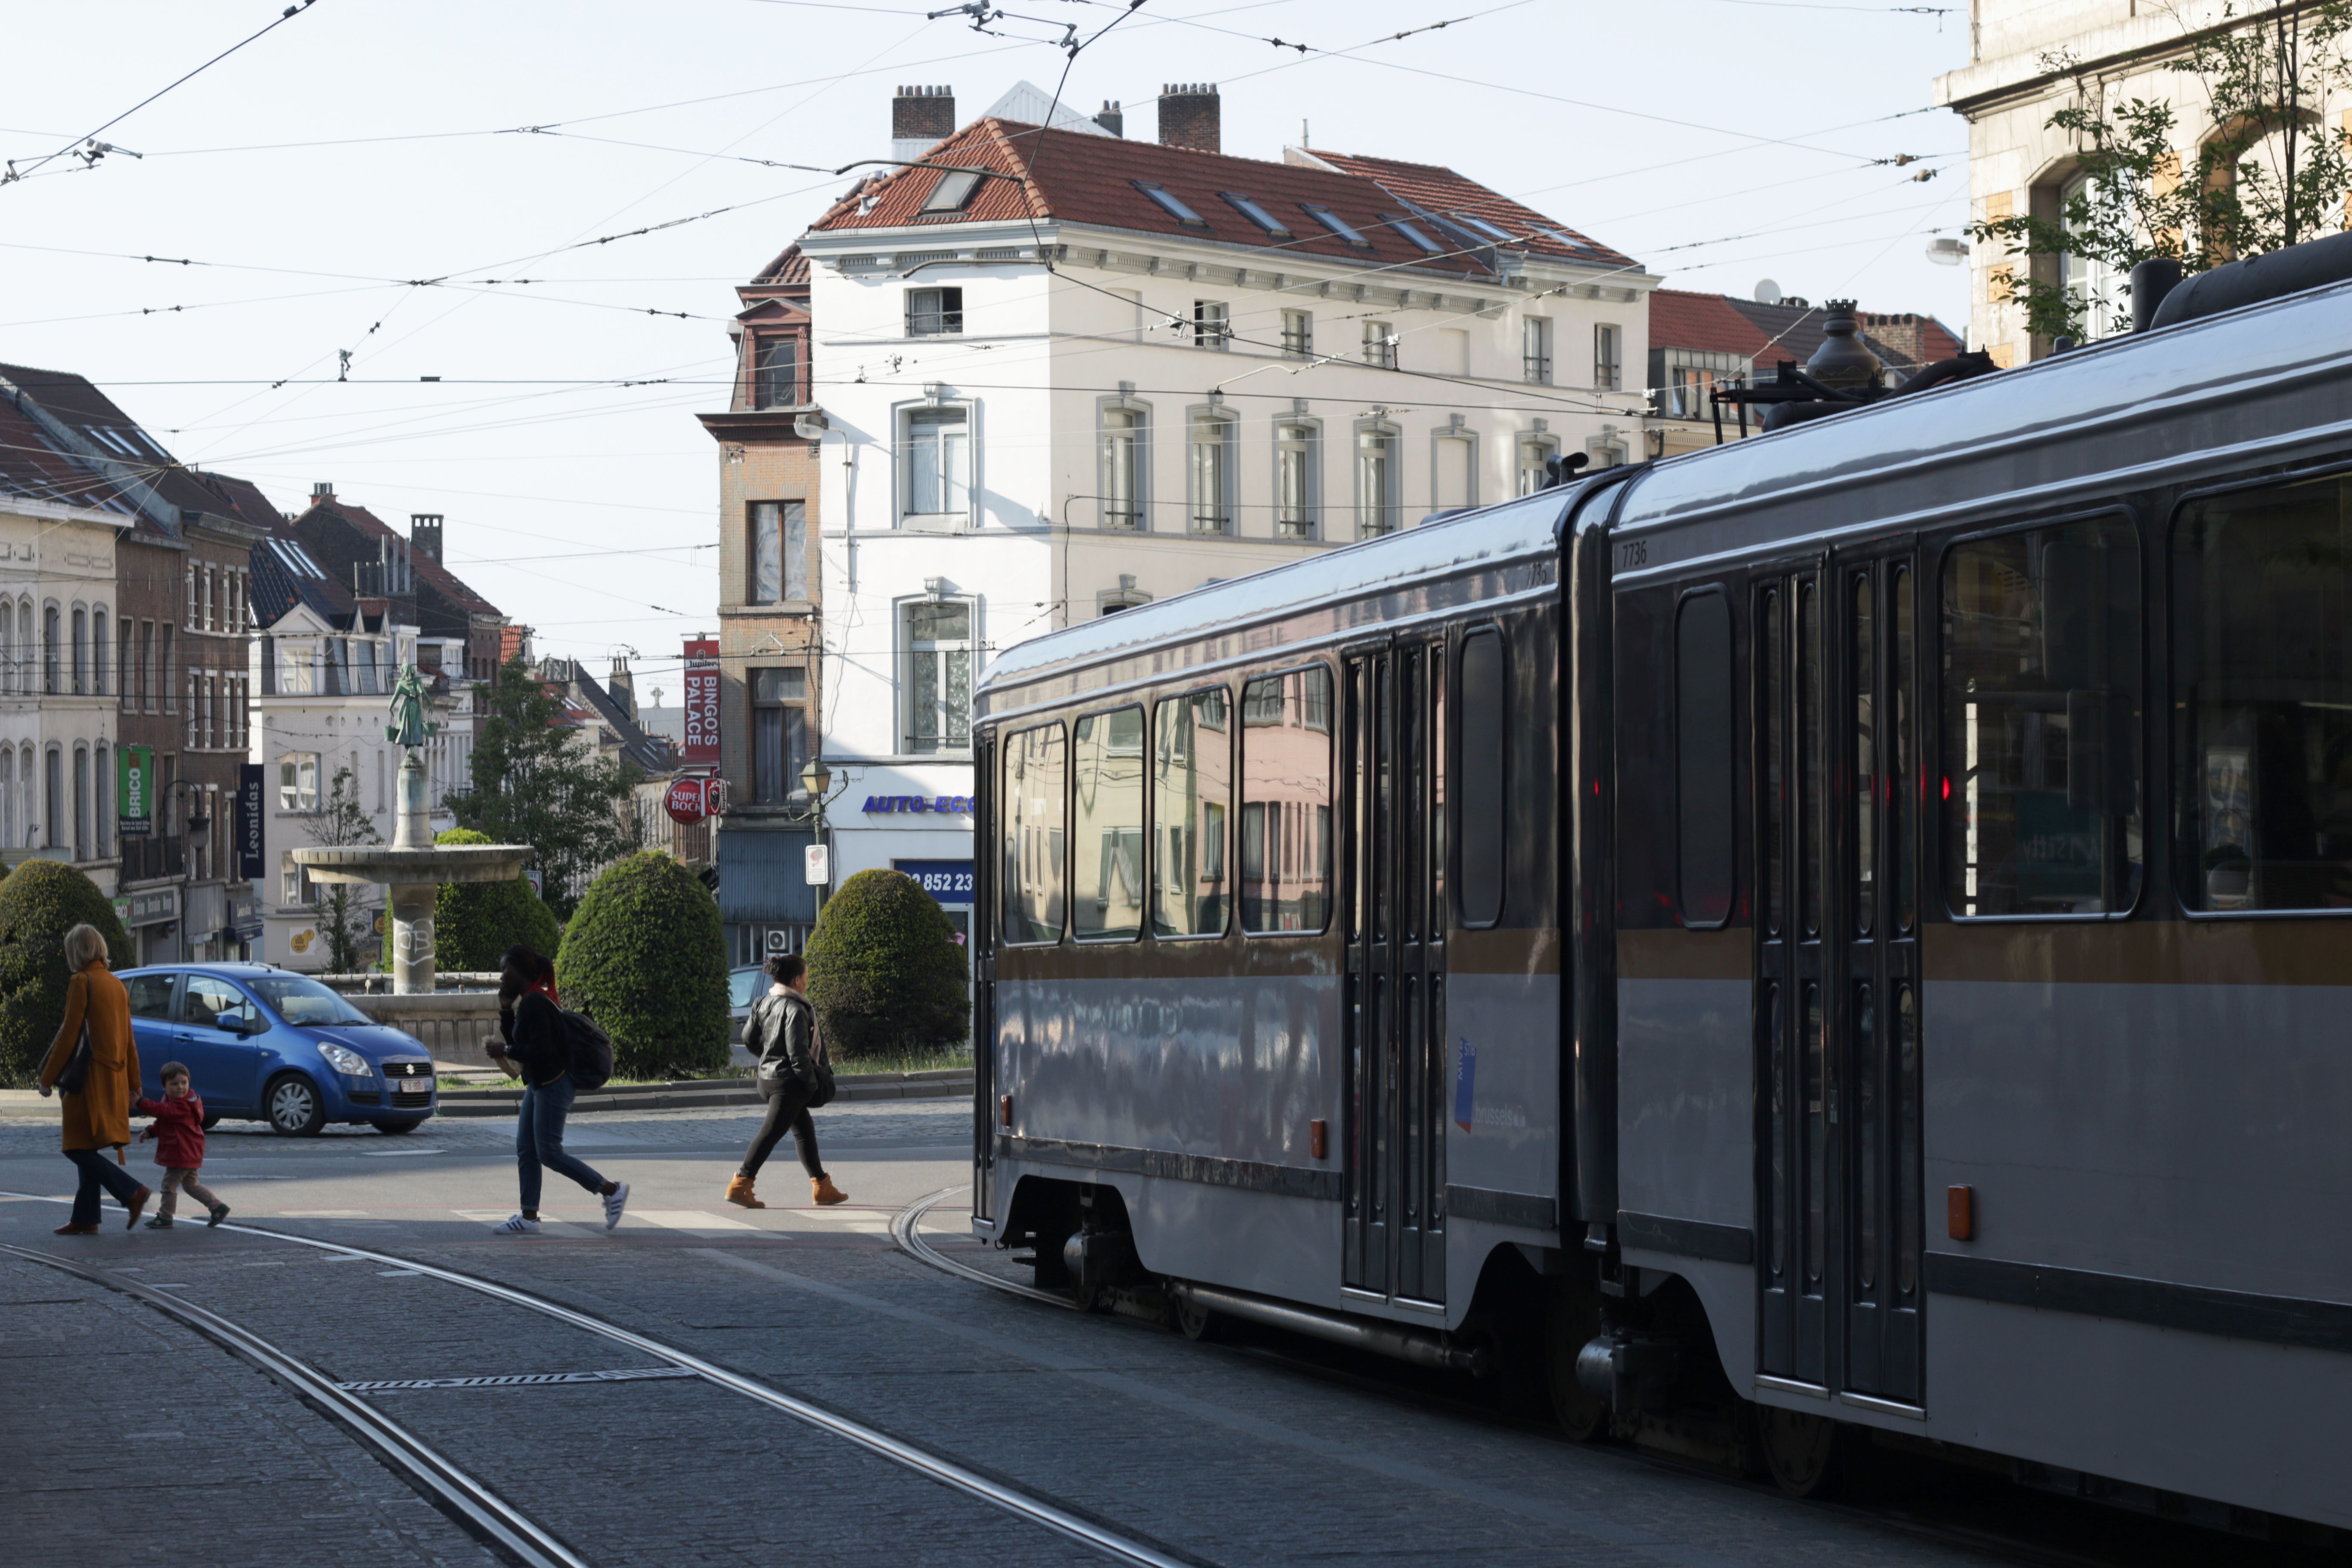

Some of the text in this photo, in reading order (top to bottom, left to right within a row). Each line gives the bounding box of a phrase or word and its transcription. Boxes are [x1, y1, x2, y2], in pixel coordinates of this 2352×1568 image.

[1623, 539, 1647, 569] 7736
[689, 660, 717, 668] Jupiler
[687, 677, 701, 746] PALACE
[704, 677, 718, 746] BINGO'S
[671, 791, 700, 802] SUPE
[245, 781, 259, 859] Leonidas
[924, 873, 952, 891] 852
[955, 873, 973, 891] 23
